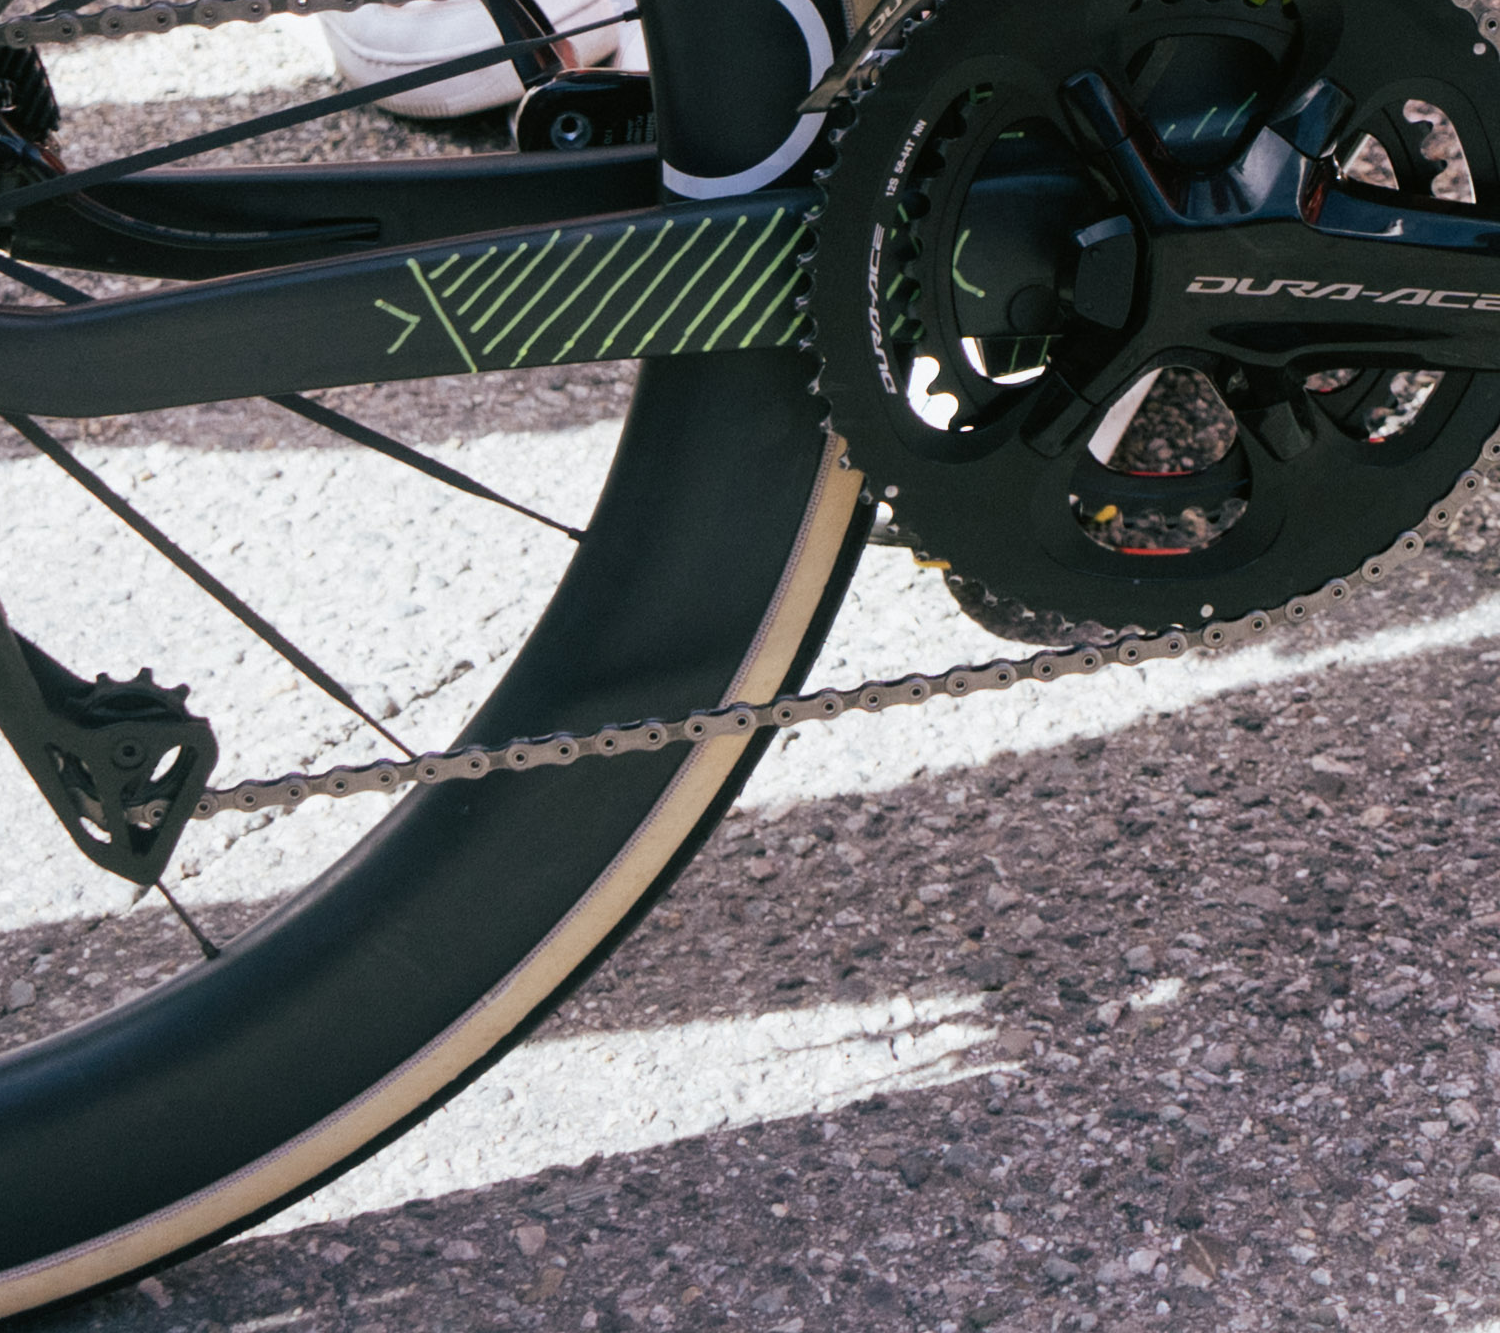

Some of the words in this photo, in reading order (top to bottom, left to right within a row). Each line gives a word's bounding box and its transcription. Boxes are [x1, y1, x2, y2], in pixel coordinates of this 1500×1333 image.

[884, 176, 900, 197] 12S
[893, 138, 917, 174] 56-44T
[870, 221, 897, 396] DURA-ACE
